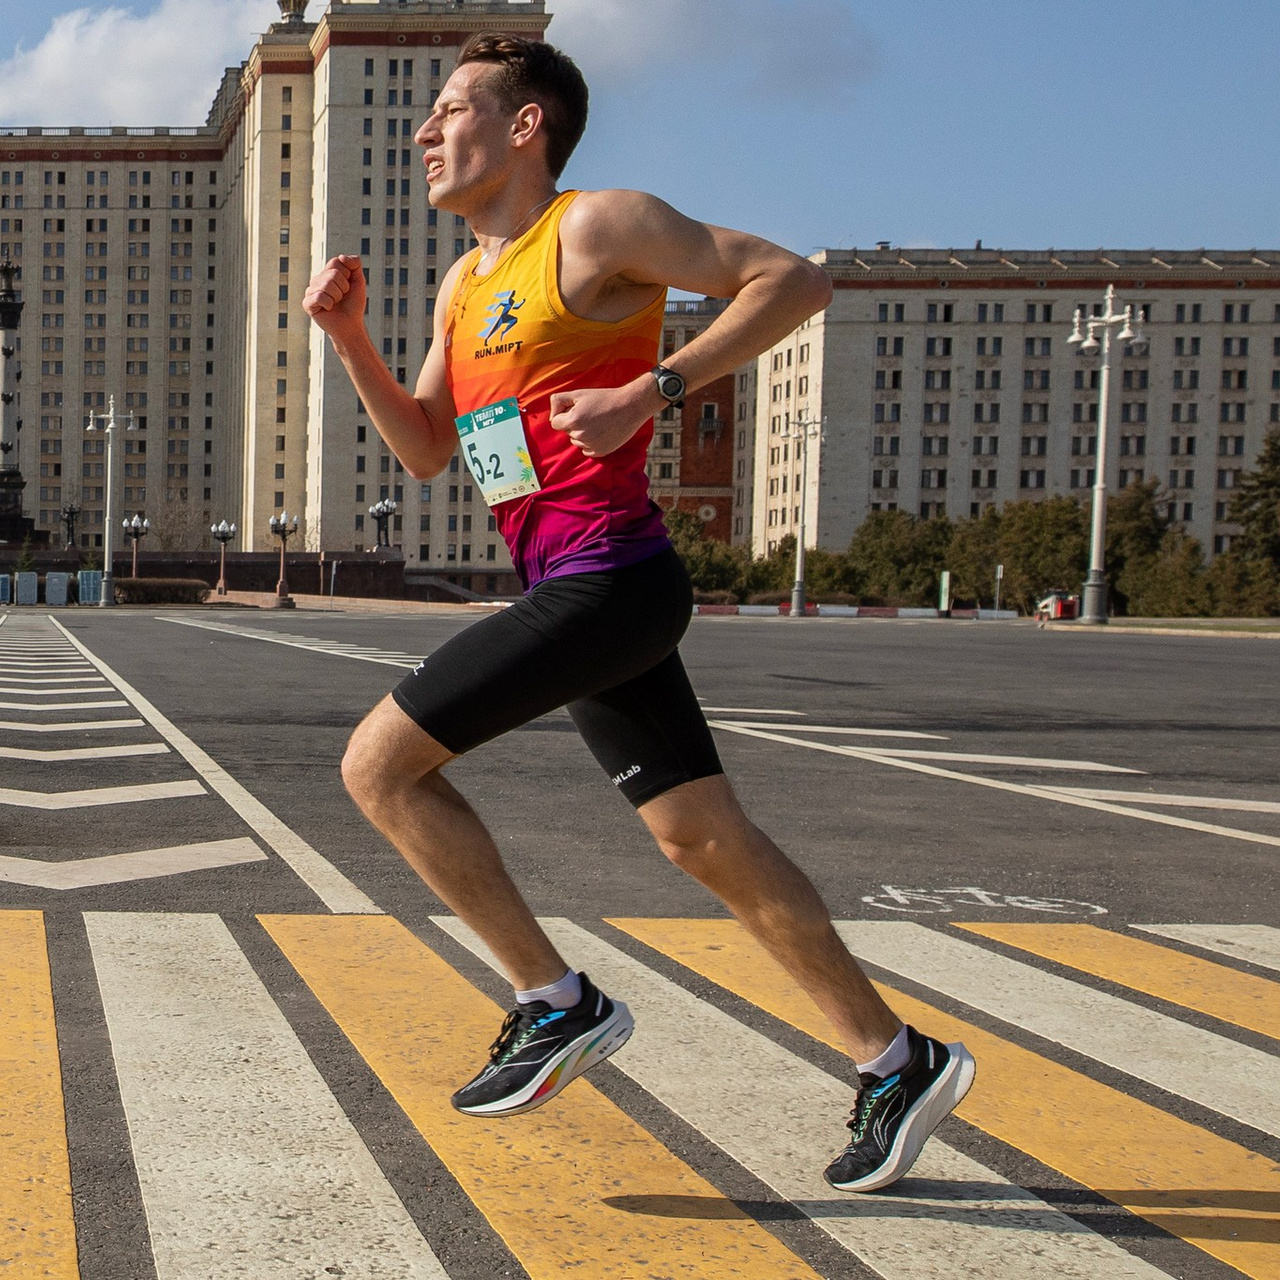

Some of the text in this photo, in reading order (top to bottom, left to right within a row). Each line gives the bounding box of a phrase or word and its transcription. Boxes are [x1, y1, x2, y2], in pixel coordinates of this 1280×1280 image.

[474, 340, 523, 360] RUN.MIPT
[475, 409, 495, 422] ТЕМП
[494, 406, 504, 416] 10
[467, 442, 505, 485] 5-2
